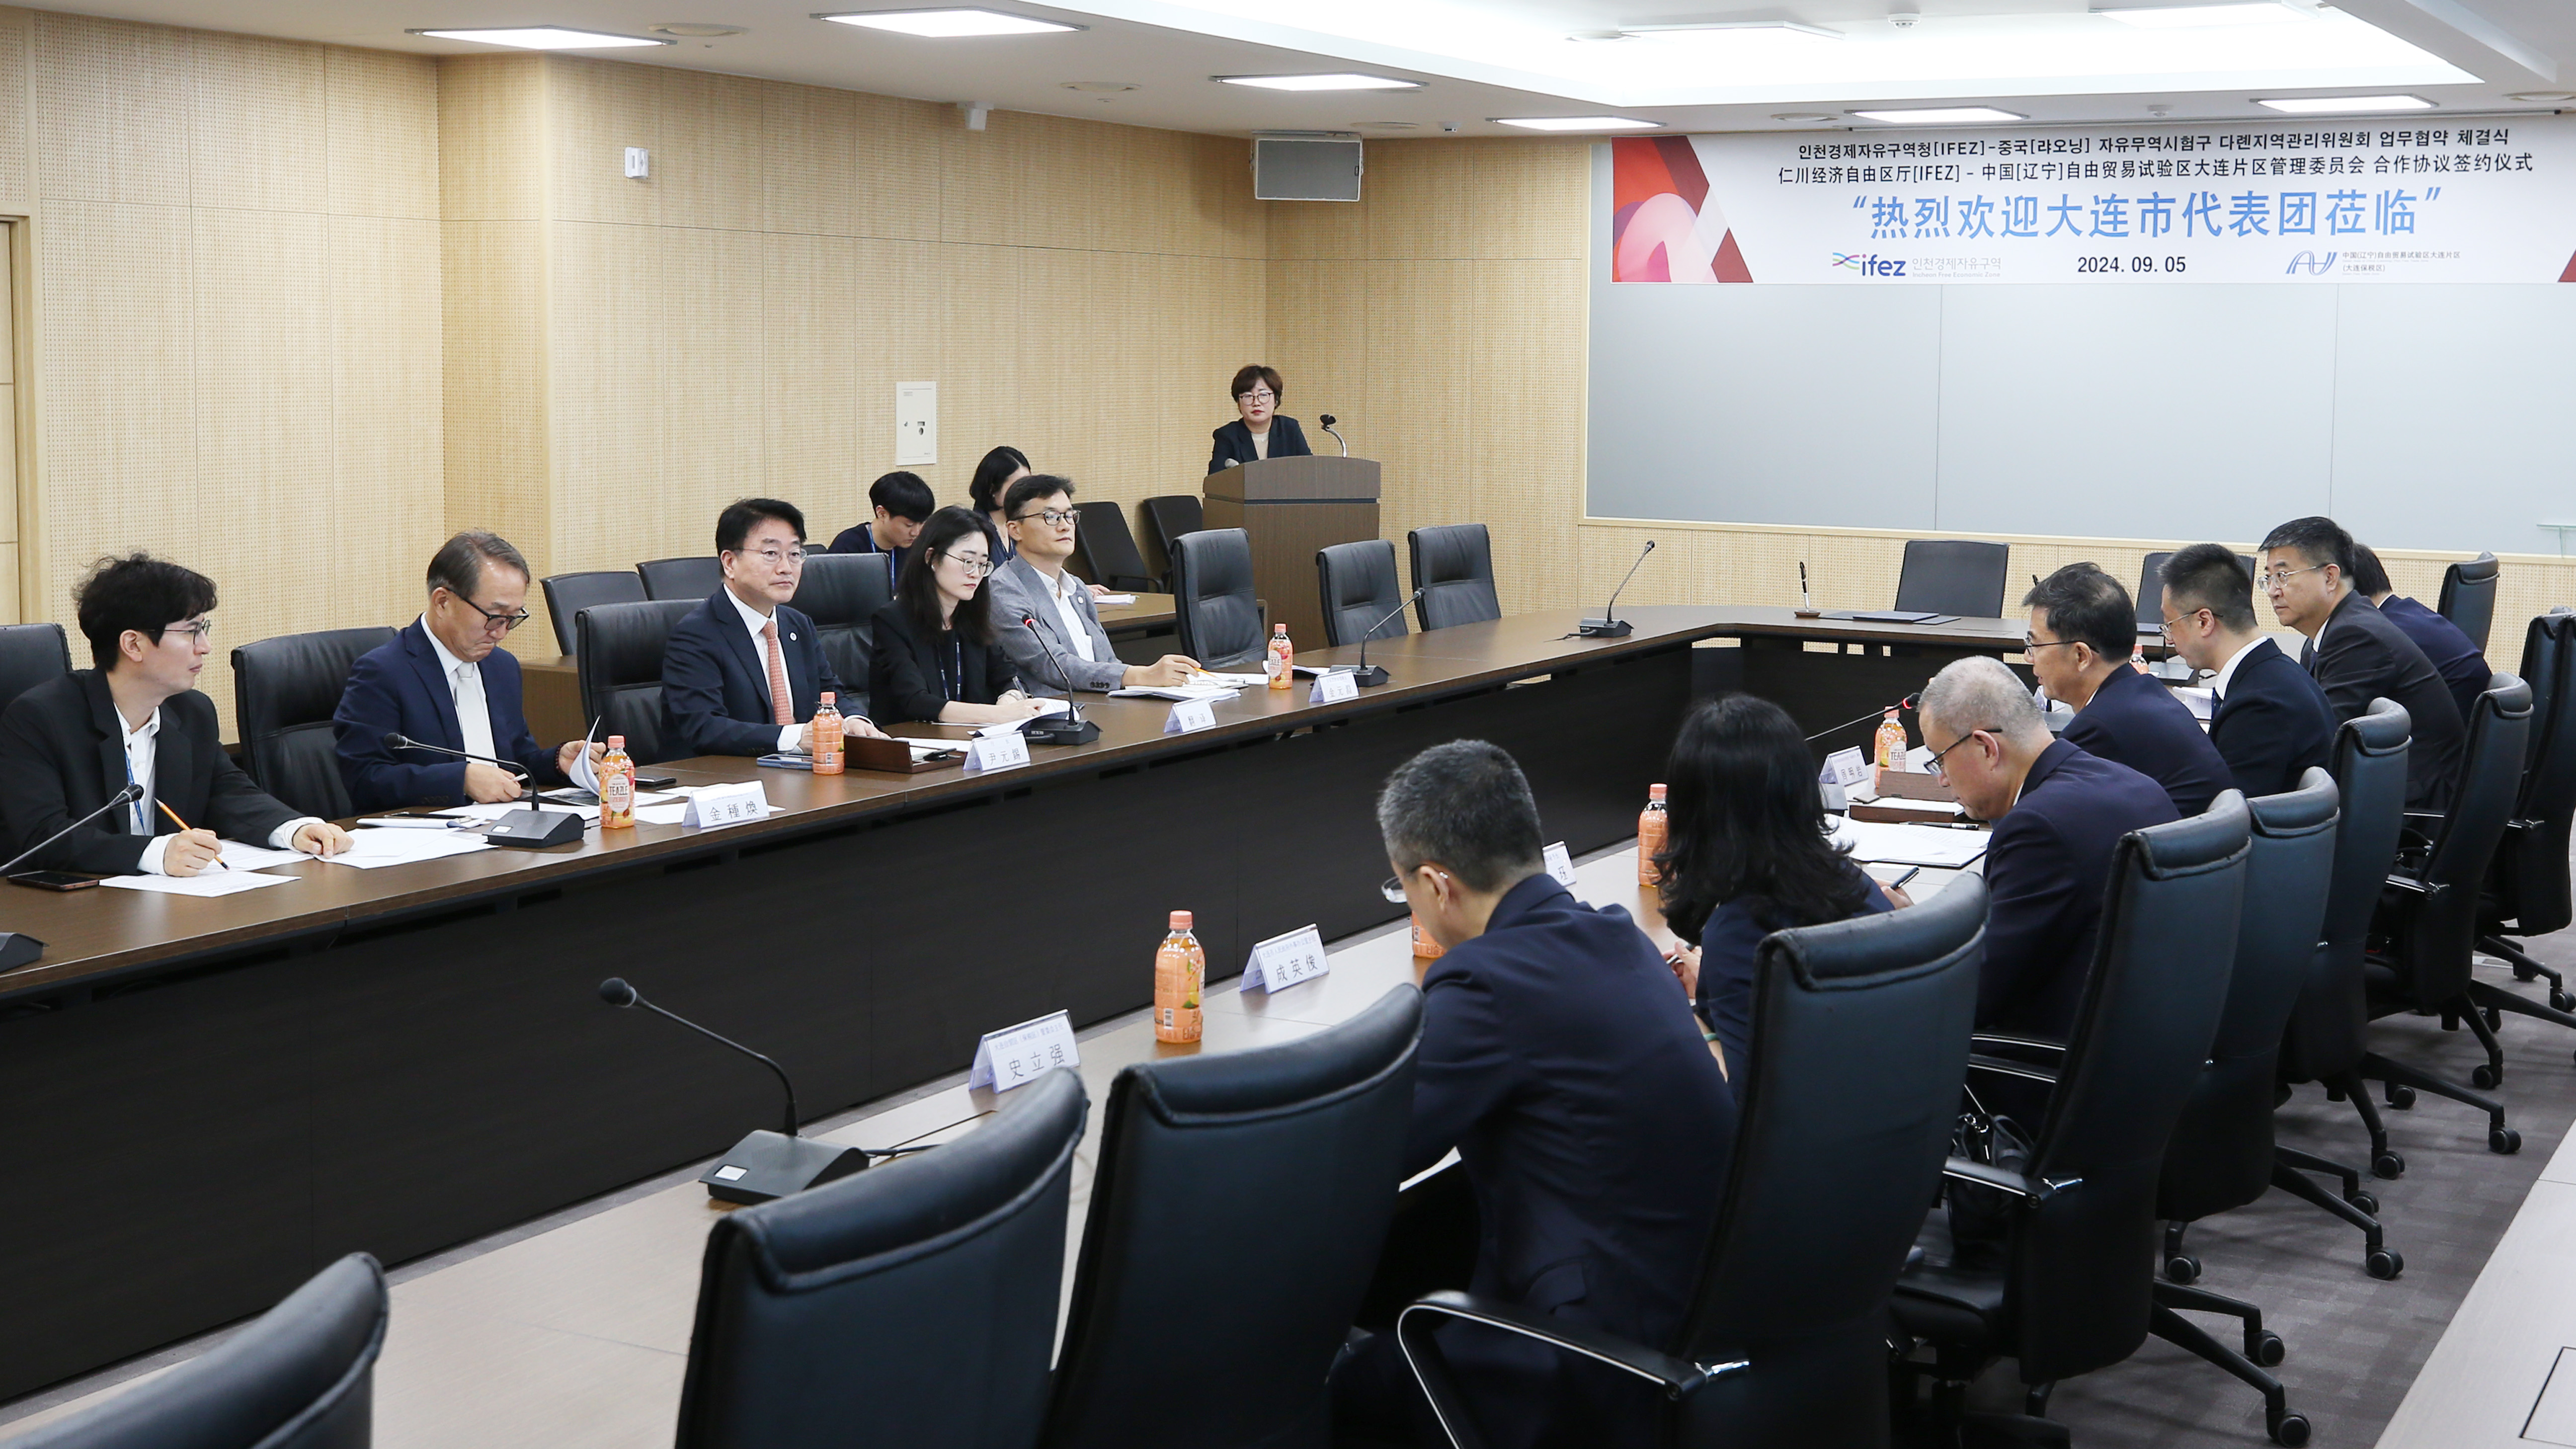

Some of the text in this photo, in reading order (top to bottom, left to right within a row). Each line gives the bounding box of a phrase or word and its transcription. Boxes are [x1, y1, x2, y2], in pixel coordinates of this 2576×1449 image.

[2098, 135, 2212, 153] 자유무역시험구
[2219, 131, 2371, 151] 다롄지역관리위원회
[2379, 130, 2449, 148] 업무협약
[2457, 128, 2509, 146] 체결식
[1778, 163, 1960, 184] 仁川经济自由区厅[IFEZ]
[1982, 156, 2365, 181] 中国[辽宁]自由贸易试验区大连片区管理委员会
[2373, 152, 2533, 174] 合作协议签约仪式
[1862, 253, 1906, 276] ifez
[1912, 257, 2001, 270] 인천경제자유구역
[2077, 256, 2186, 273] 2024. 09. 05
[609, 786, 628, 796] TEAZLE
[1276, 953, 1318, 983] 成英俊
[1009, 1043, 1065, 1081] 史立强
